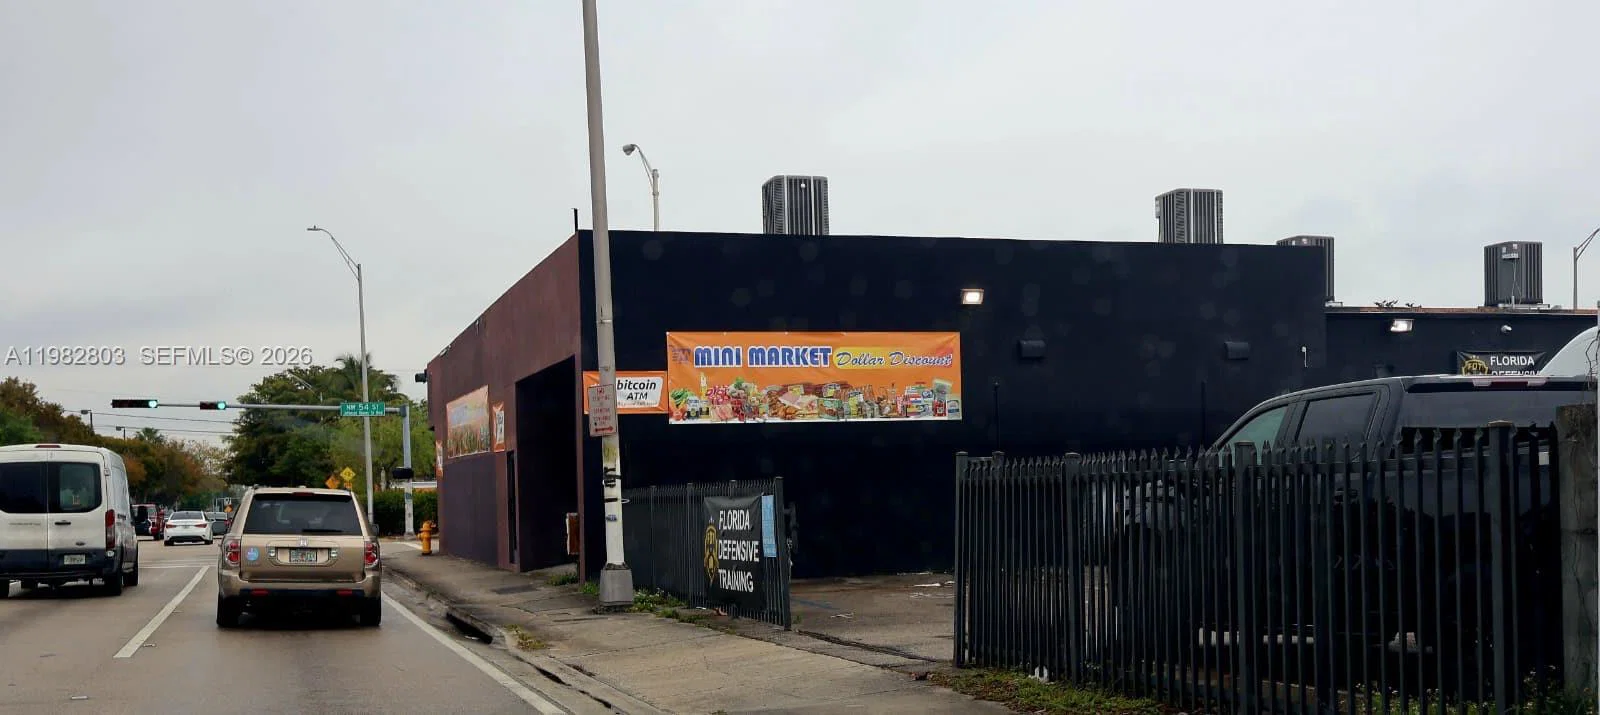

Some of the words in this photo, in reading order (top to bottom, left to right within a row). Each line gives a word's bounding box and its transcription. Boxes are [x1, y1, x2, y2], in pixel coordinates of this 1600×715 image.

[694, 346, 742, 367] MINI
[748, 346, 832, 367] MARKET
[836, 351, 885, 366] Dollar
[889, 351, 953, 367] Discount
[1490, 356, 1535, 365] FLORIDA
[617, 379, 656, 390] bitcoin
[627, 392, 648, 400] ATM
[719, 510, 750, 530] FLORIDA
[718, 540, 760, 562] DEFENSIVE
[718, 569, 754, 593] TRAINING
